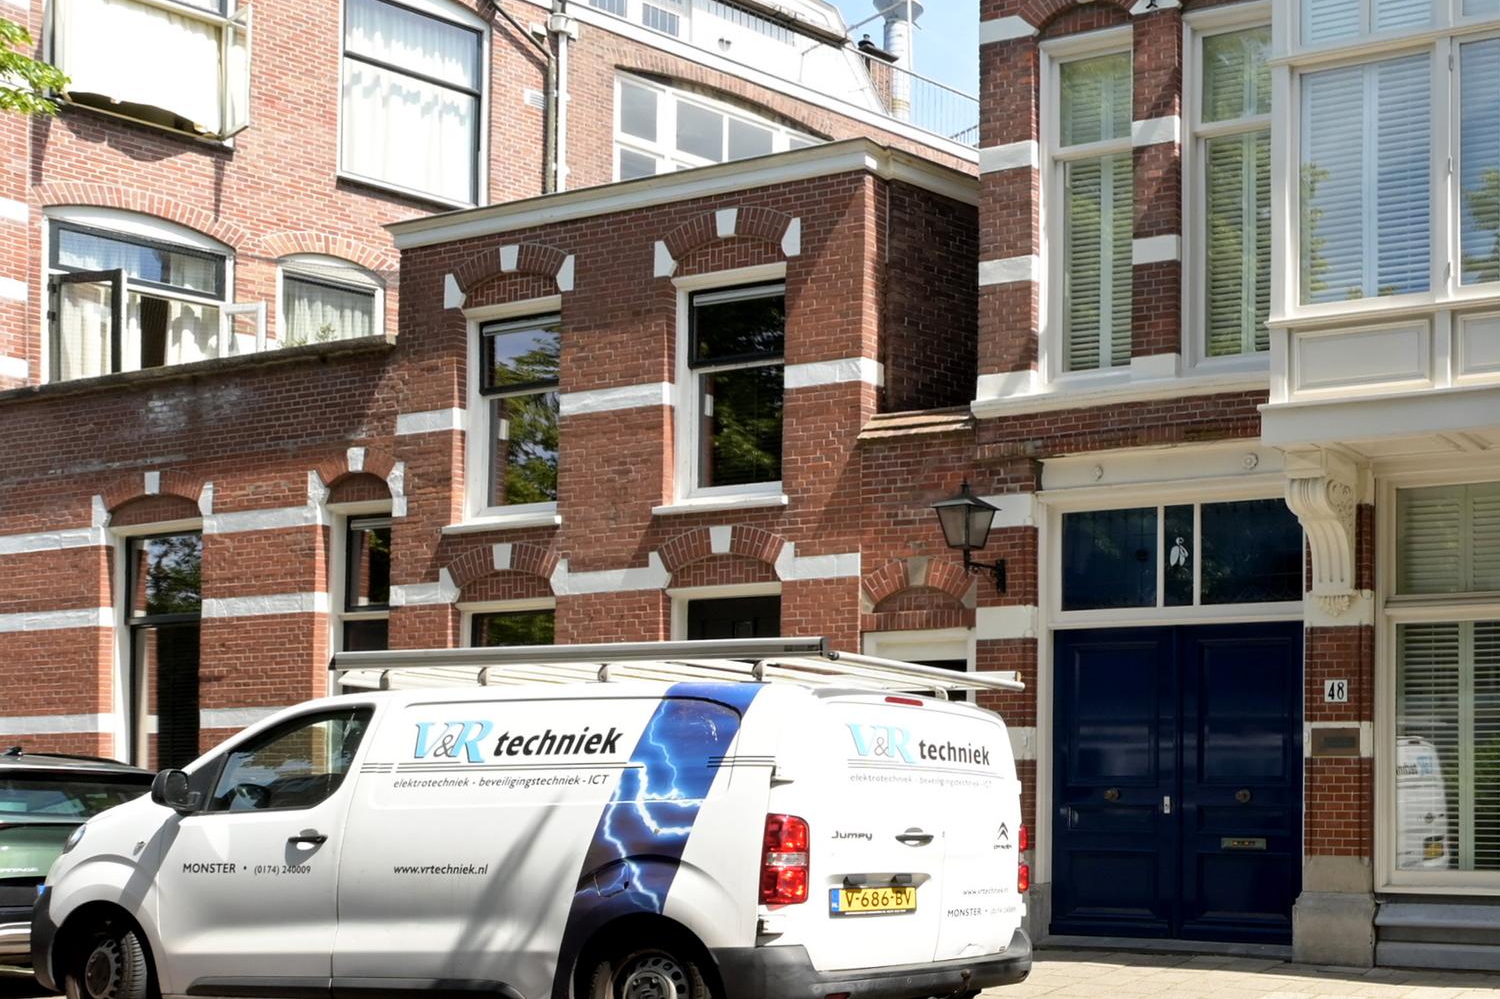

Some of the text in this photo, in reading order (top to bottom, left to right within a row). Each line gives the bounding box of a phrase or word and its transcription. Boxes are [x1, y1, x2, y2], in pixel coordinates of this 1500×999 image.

[1328, 681, 1345, 700] 48
[414, 720, 624, 763] V&R techniek
[845, 722, 991, 766] V&R techniek
[393, 777, 470, 788] elektrotechniek
[478, 775, 580, 788] beveiligingstechniek
[588, 774, 609, 785] ICT
[182, 862, 312, 876] MONSTER (0174) 240009
[393, 863, 489, 875] www.vrtechniek.nl
[845, 888, 912, 908] V-686-BV
[947, 906, 982, 918] MONSTER
